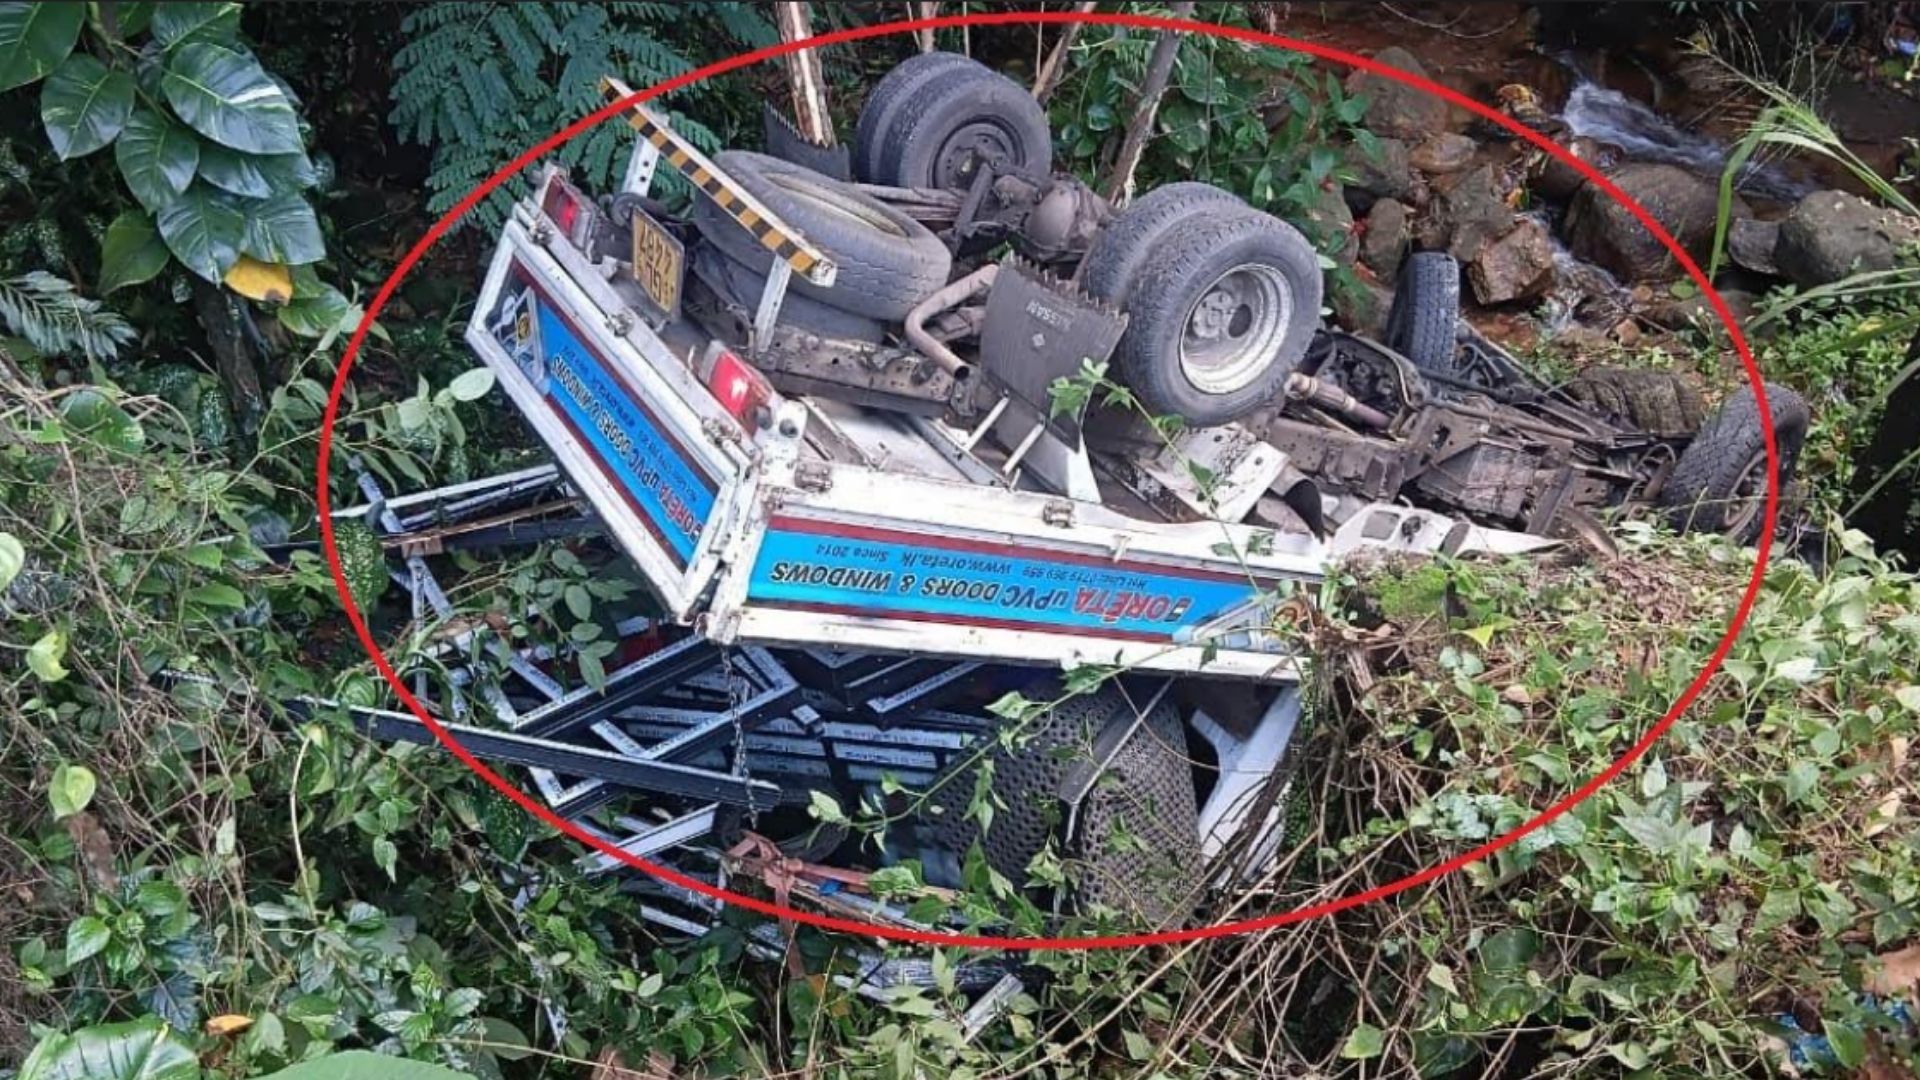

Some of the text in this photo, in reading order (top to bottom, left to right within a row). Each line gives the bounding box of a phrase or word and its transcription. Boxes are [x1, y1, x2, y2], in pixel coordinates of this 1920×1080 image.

[552, 355, 593, 409] WINDOWS
[816, 544, 847, 558] 2014
[853, 548, 889, 563] Since
[901, 551, 1012, 574] www.oreta.lk
[771, 561, 893, 592] WINDOWS
[899, 573, 917, 593] &
[921, 576, 999, 601] DOORS
[1001, 584, 1070, 611] uPVC
